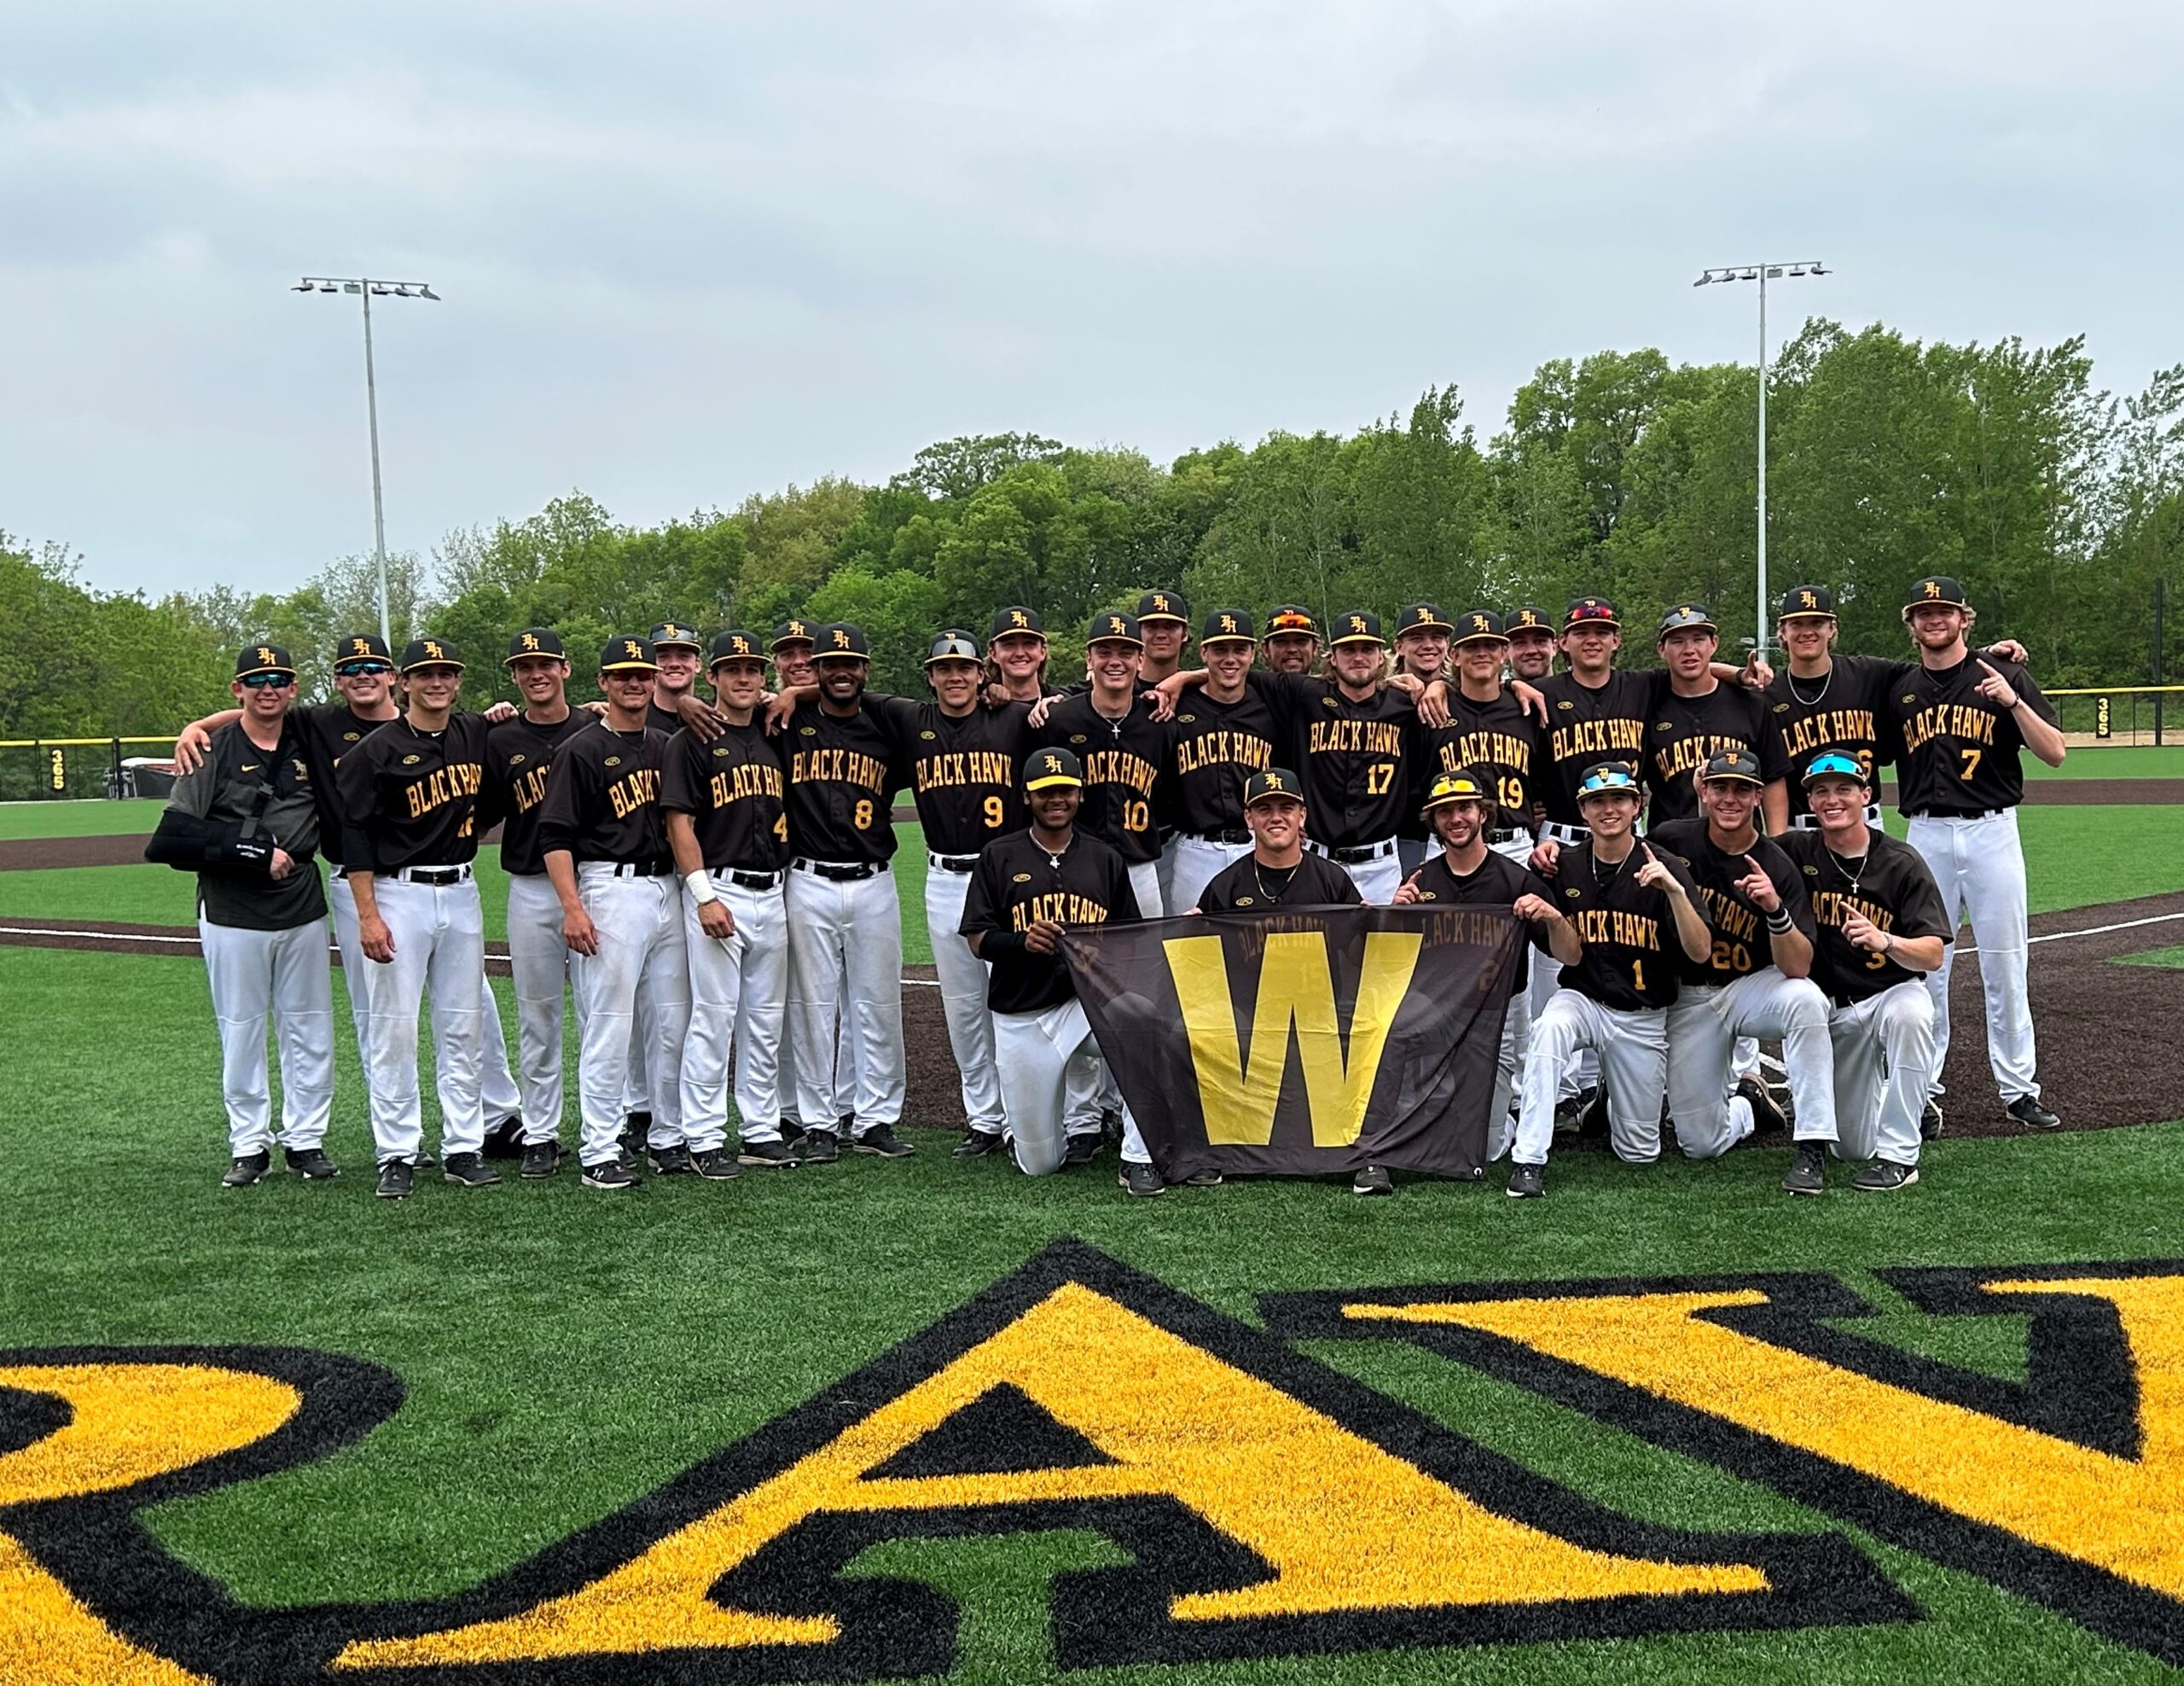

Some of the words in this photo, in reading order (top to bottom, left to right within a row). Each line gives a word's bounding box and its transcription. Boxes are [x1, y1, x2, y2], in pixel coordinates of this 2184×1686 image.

[1781, 713, 1831, 758] LACK
[1831, 709, 1876, 741] HAWK
[1902, 704, 1947, 755] BLACK
[1950, 704, 1997, 747] HAWK
[2098, 697, 2109, 736] 365
[1178, 731, 1229, 776] BLACK
[1233, 731, 1272, 771] HAWK
[1310, 720, 1362, 755] BLACK
[1366, 722, 1401, 758] HAWK
[1439, 732, 1490, 772] BLACK
[1492, 733, 1531, 776] HAWK
[1552, 720, 1607, 763] BLACK
[1655, 735, 1706, 782] BLACK
[51, 749, 65, 790] 365
[792, 749, 844, 784] BLACK
[846, 752, 887, 796] HAWK
[915, 753, 966, 794] BLACK
[968, 752, 1013, 788] HAWK
[1087, 751, 1118, 786] ACK
[1120, 753, 1158, 801] HAWK
[1367, 764, 1394, 795] 17
[1960, 749, 1981, 781] 7
[405, 765, 462, 818] BLACK
[711, 764, 762, 809] BLACK
[1497, 776, 1524, 809] 19
[773, 811, 787, 843] 4
[855, 799, 873, 830] 8
[984, 796, 1003, 828] 9
[1123, 799, 1148, 832] 10
[1714, 892, 1758, 942] HAWK
[1812, 890, 1843, 927] ACK
[1612, 910, 1661, 951] HAWK
[1632, 959, 1647, 990] 1
[1712, 940, 1751, 971] 20
[1162, 931, 1423, 1148] W
